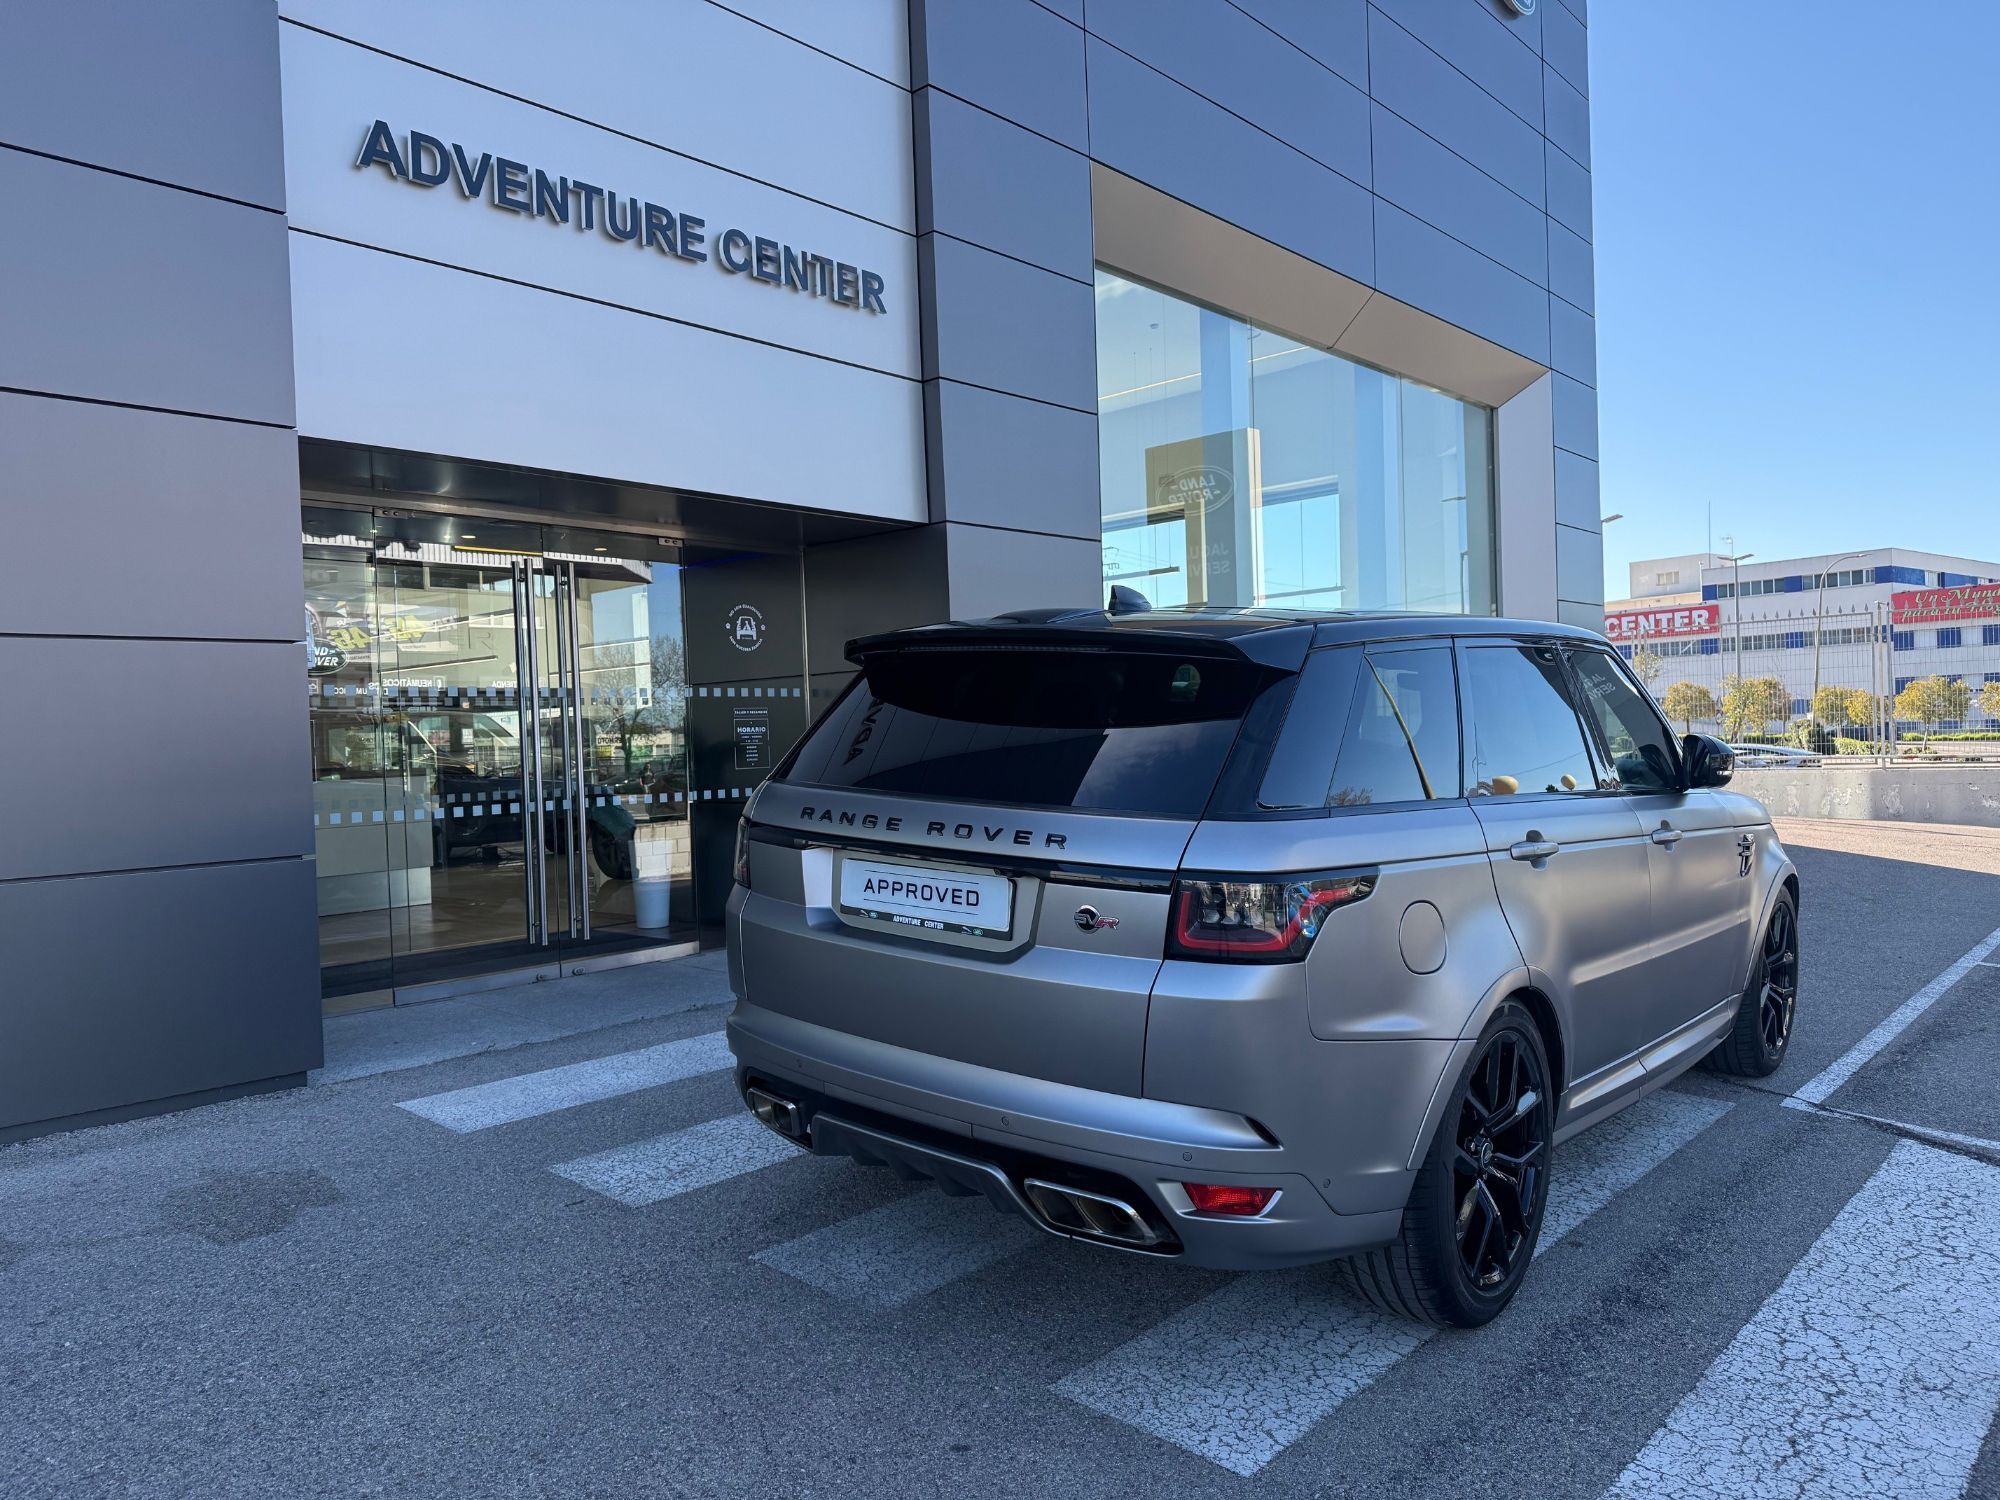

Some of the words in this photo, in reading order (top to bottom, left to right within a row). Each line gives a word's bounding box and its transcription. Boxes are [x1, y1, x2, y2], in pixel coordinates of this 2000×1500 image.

[356, 119, 708, 264] ADVENTURE
[719, 229, 888, 315] CENTER
[1604, 609, 1711, 638] CENTER
[800, 806, 903, 832] RANGE
[926, 821, 1067, 850] ROVER
[863, 878, 980, 907] APPROVED
[893, 915, 921, 926] ADVENTURE
[924, 920, 944, 930] CENTER
